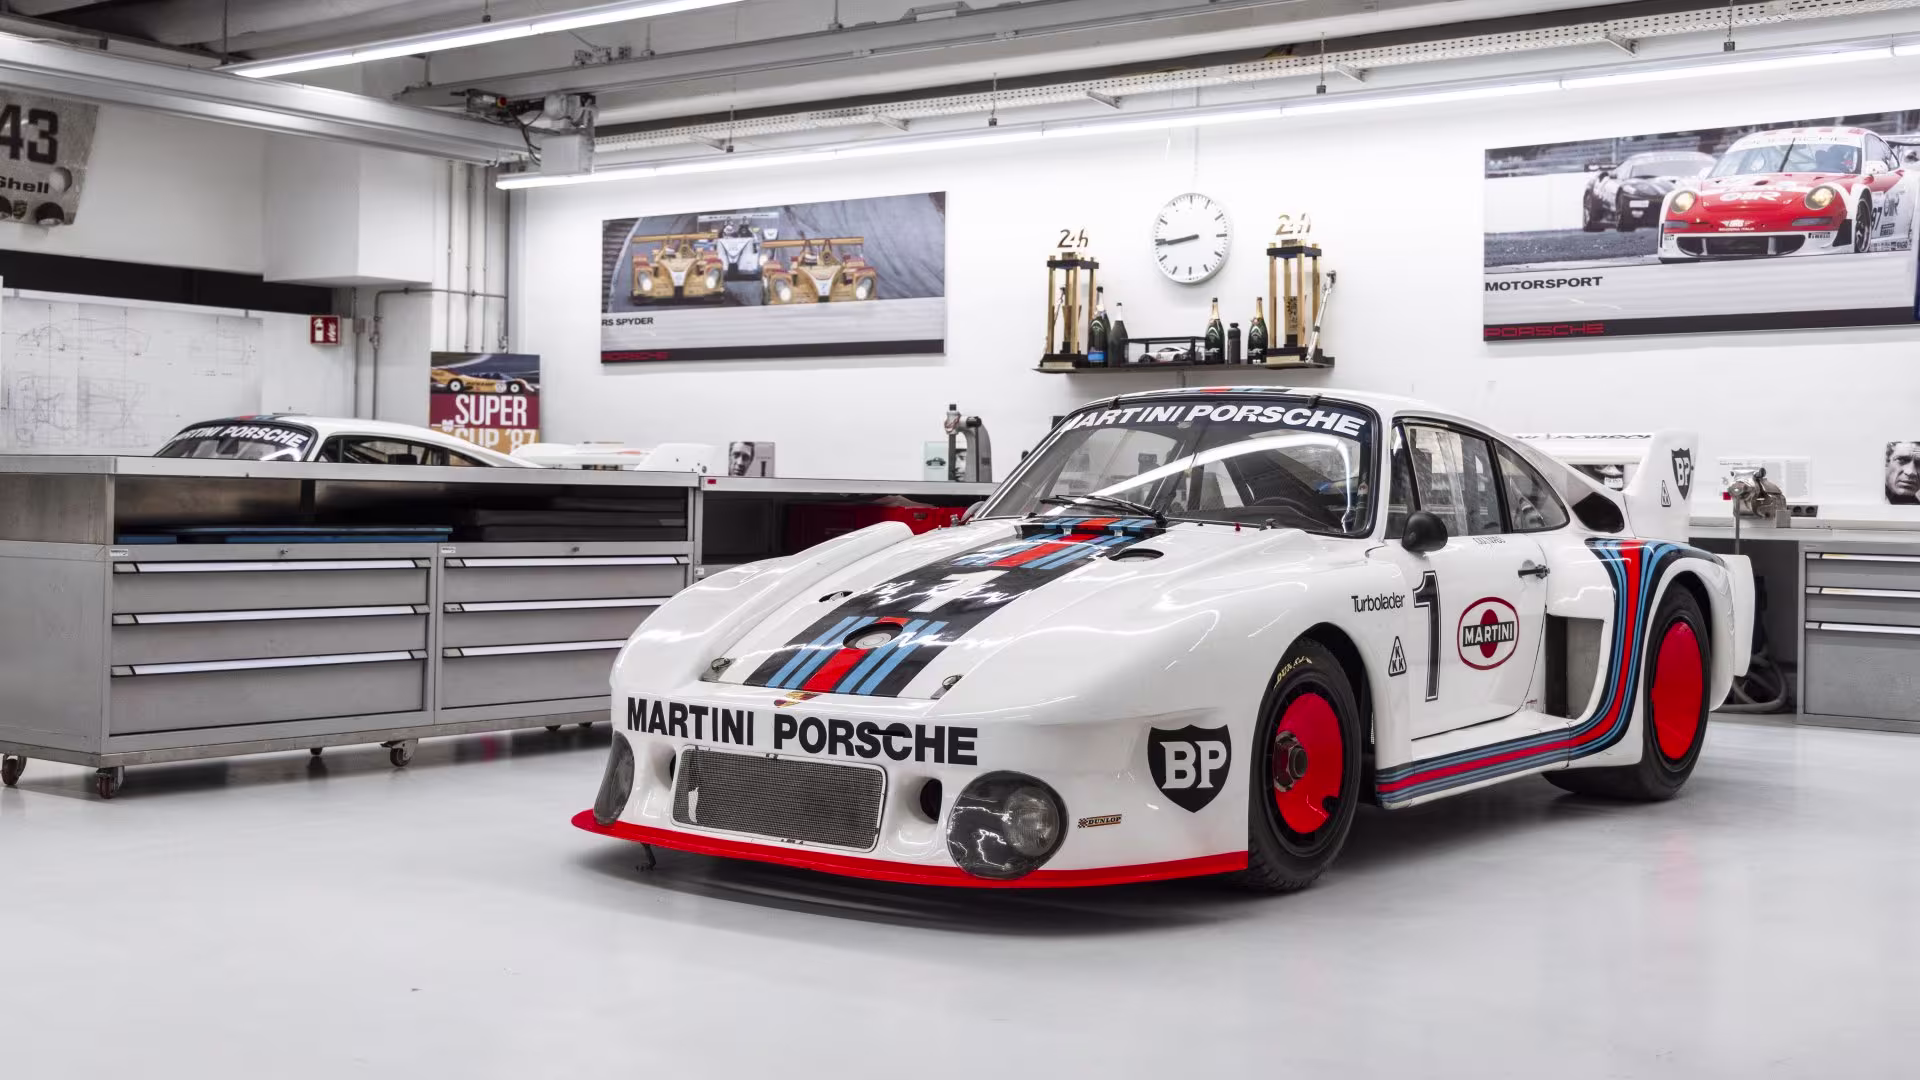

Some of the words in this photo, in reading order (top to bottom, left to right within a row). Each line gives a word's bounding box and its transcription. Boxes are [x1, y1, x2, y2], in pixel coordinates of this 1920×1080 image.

[0, 104, 58, 165] 43
[1485, 276, 1603, 291] MOTORSPORT
[616, 317, 654, 326] SPYDER
[1484, 322, 1605, 337] PORSCHE
[455, 394, 527, 426] SUPER
[1060, 406, 1186, 432] MARTINI
[1187, 405, 1366, 436] PORSCHE
[222, 426, 308, 448] PORSCHE
[1674, 457, 1690, 486] BP
[1351, 592, 1405, 613] Turbolader
[1412, 570, 1441, 702] 1
[1465, 624, 1513, 645] MARTINI
[627, 697, 754, 747] MARTINI
[774, 713, 978, 766] PORSCHE
[1159, 740, 1227, 789] BP
[1088, 816, 1121, 825] DUNLOP
